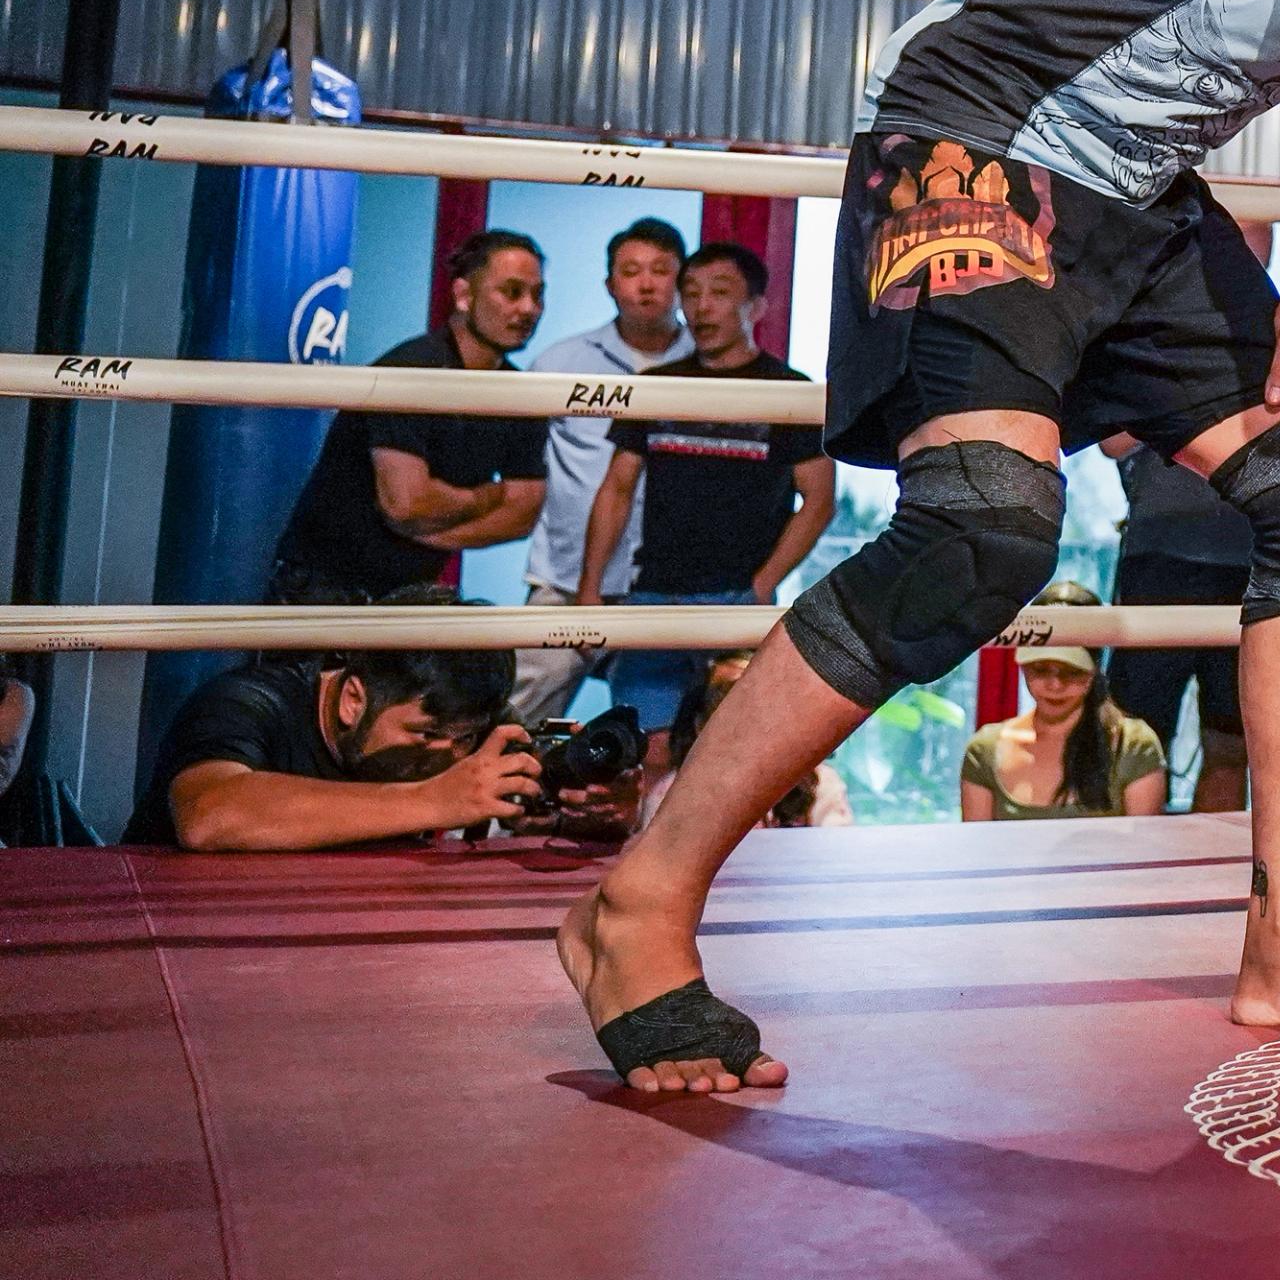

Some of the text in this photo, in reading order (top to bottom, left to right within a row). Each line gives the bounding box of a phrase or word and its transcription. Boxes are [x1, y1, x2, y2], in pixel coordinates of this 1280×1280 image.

[929, 250, 1004, 290] BJJ
[303, 306, 350, 361] RA
[54, 356, 133, 380] RAM
[566, 382, 634, 409] RAM
